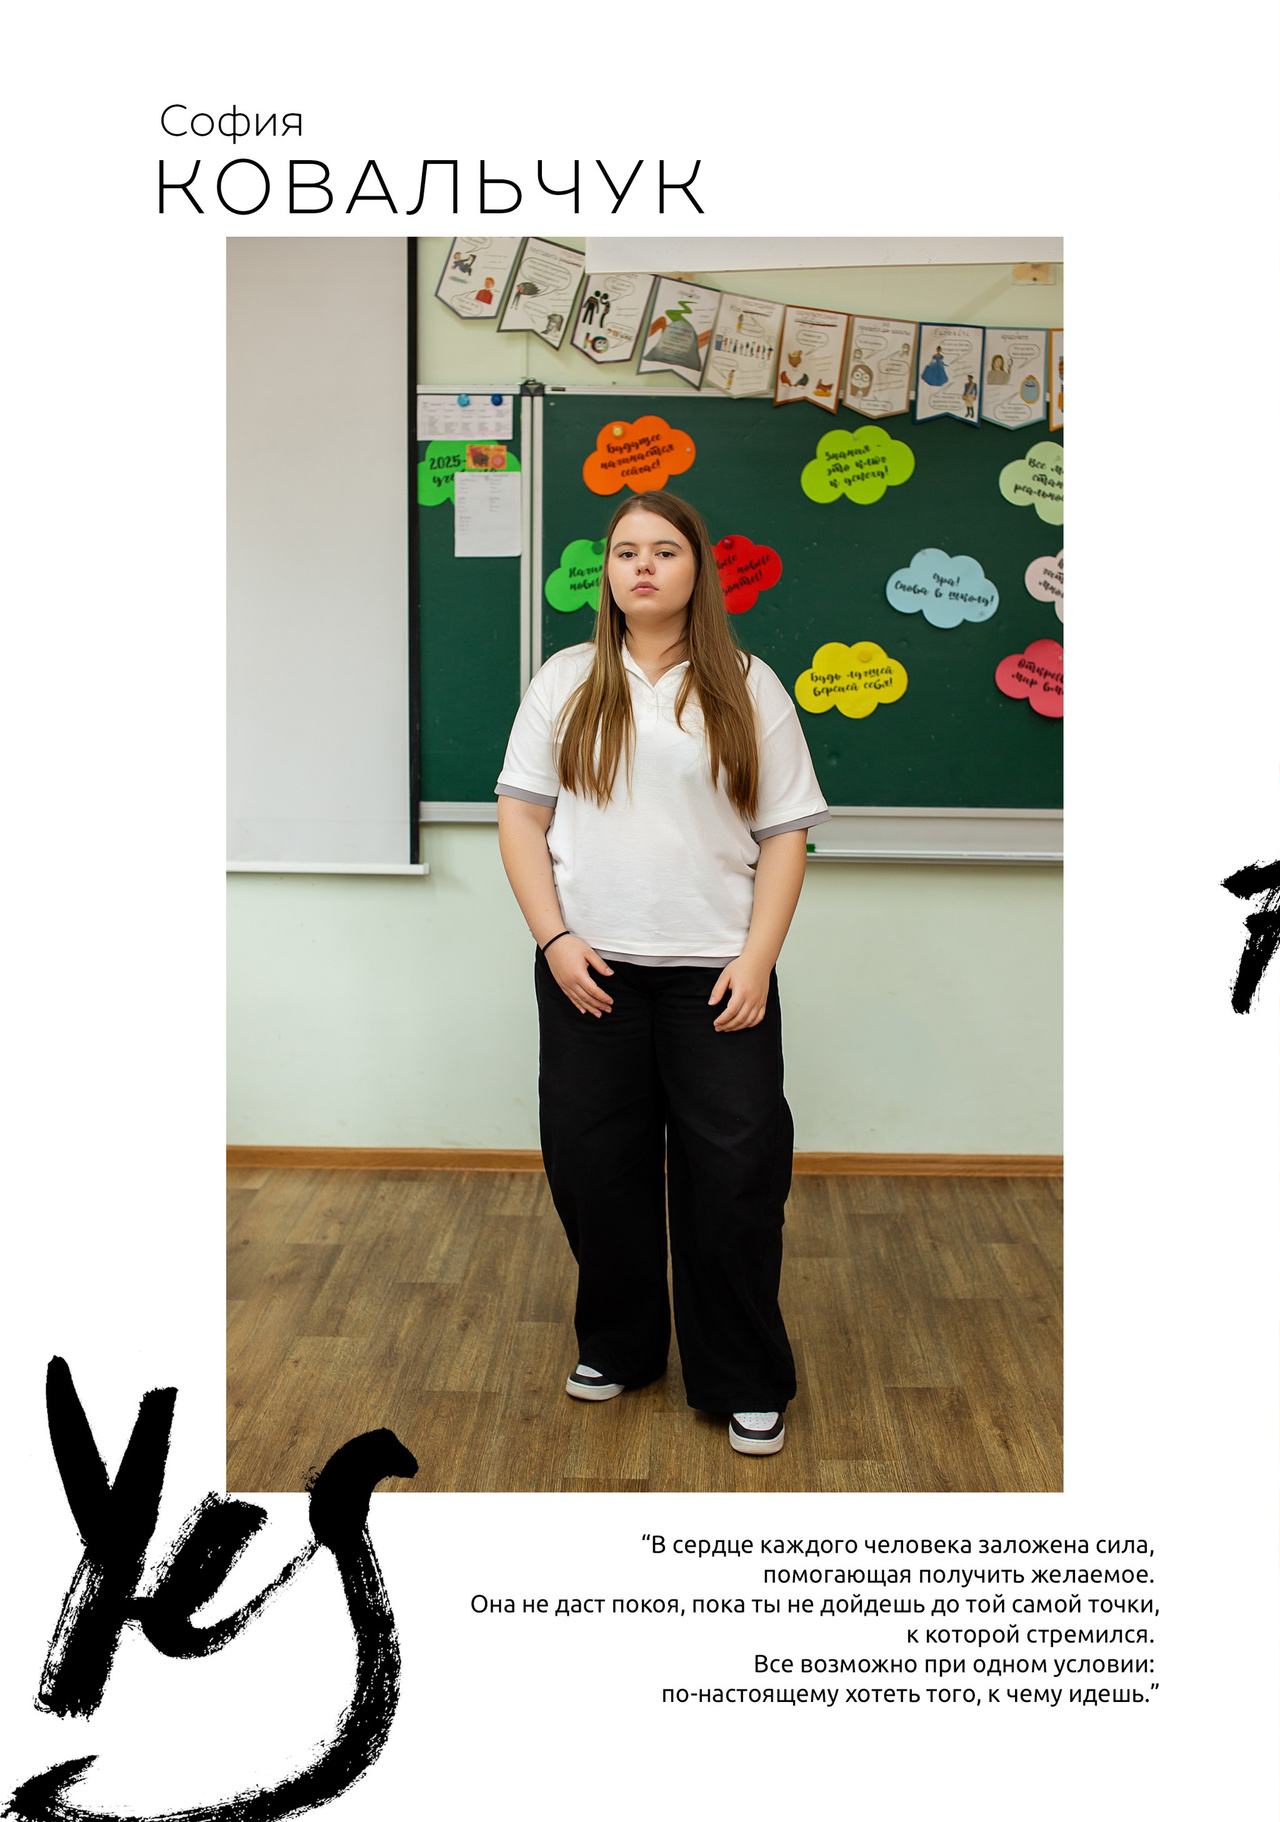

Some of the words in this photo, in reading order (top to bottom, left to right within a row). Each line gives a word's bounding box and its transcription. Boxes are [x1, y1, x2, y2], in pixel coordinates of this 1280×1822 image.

[606, 433, 661, 454] Будущее
[824, 445, 870, 461] Знания
[428, 454, 467, 470] 2025-
[600, 443, 675, 470] начинается
[827, 463, 850, 476] это
[855, 456, 887, 469] ключ
[621, 458, 661, 478] сейчас!
[844, 465, 889, 486] успеху!
[1013, 483, 1063, 502] реально
[932, 572, 960, 587] Ура!
[894, 580, 928, 596] Снова
[948, 590, 995, 607] школу!
[810, 671, 841, 684] Будь
[846, 665, 893, 680] лучшей
[813, 682, 859, 697] версией
[863, 676, 893, 690] себя!
